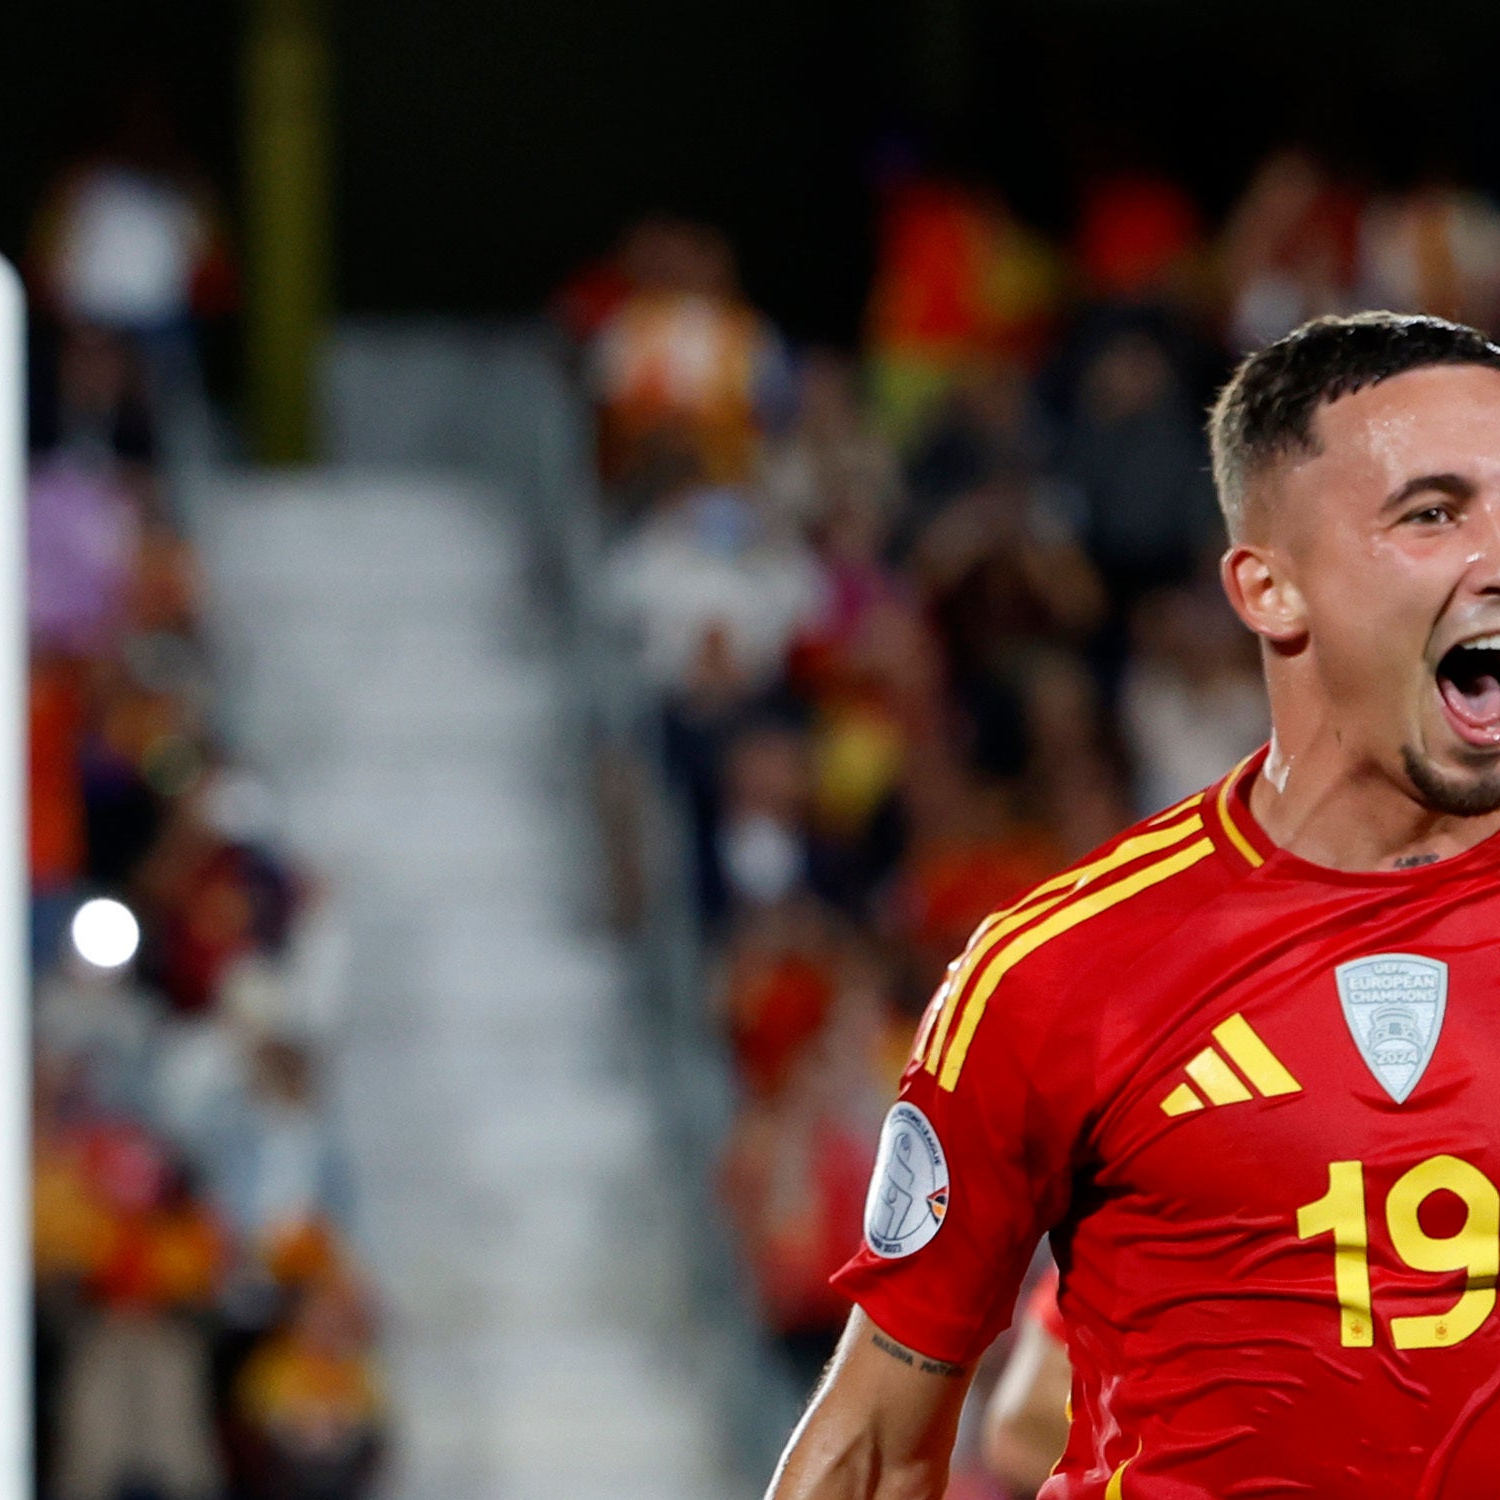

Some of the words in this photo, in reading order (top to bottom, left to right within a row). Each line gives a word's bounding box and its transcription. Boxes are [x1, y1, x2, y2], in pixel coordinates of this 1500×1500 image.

[1349, 975, 1435, 989] EUROPEAN
[1350, 990, 1437, 1003] CHAMPIONS
[1376, 1053, 1418, 1065] 2024
[1297, 1154, 1500, 1350] 19
